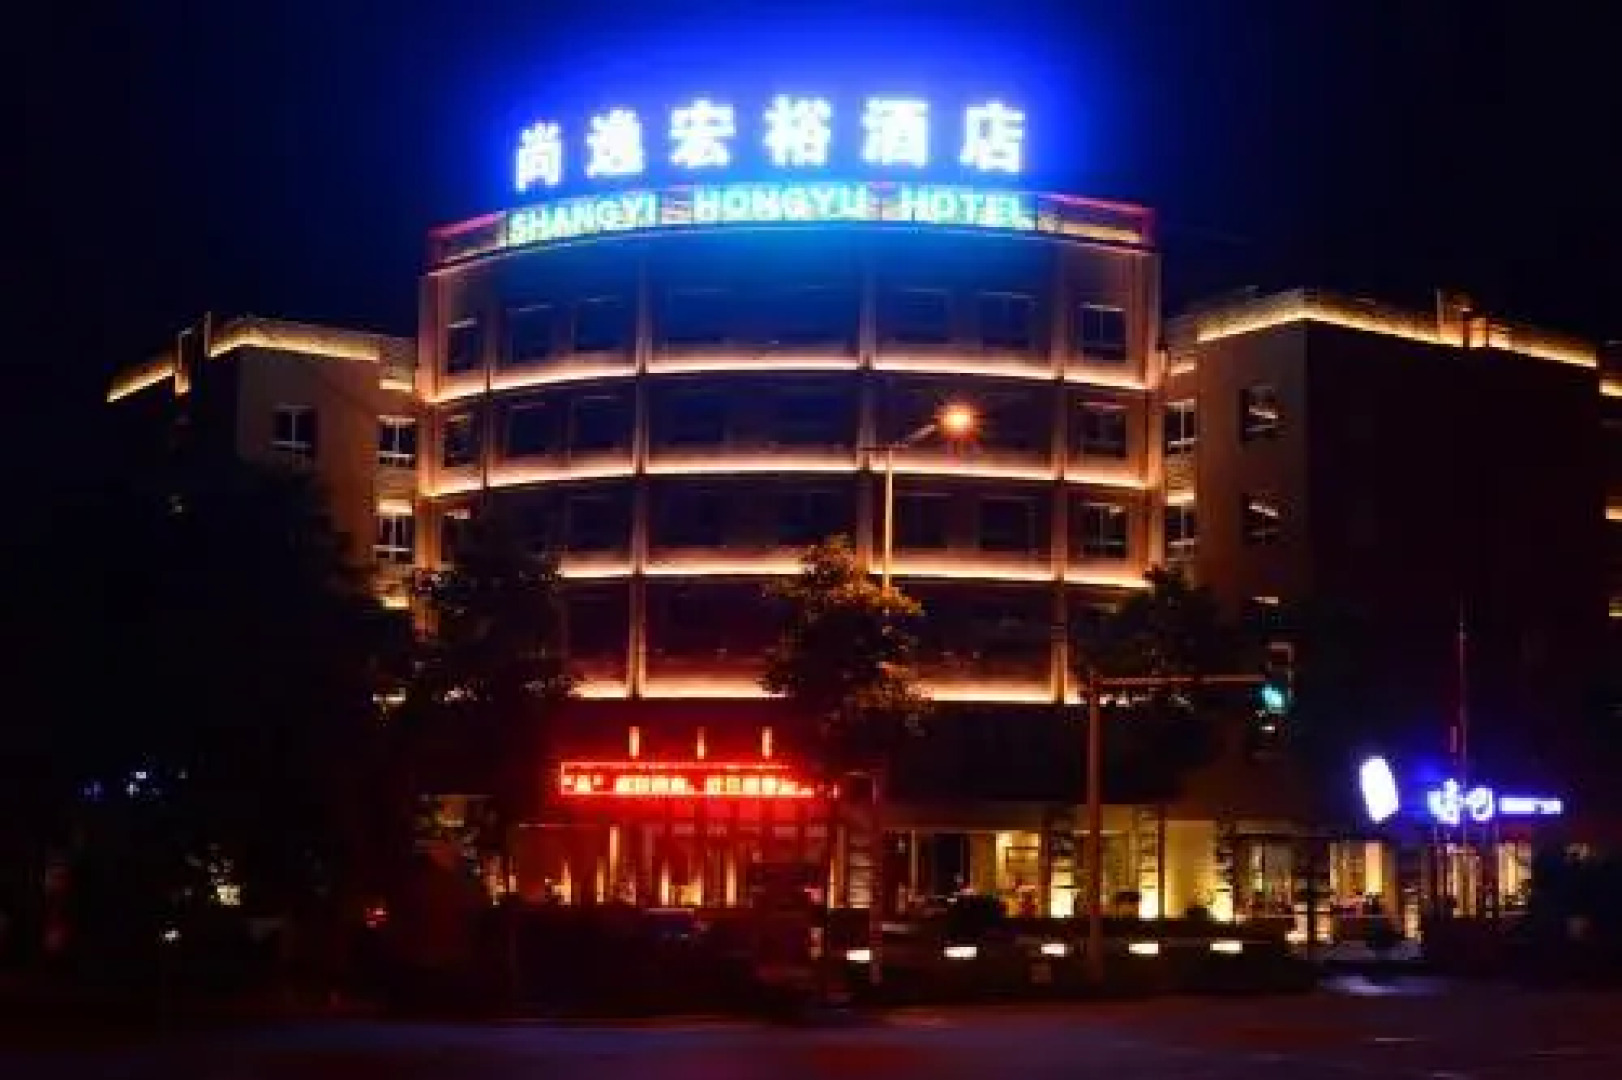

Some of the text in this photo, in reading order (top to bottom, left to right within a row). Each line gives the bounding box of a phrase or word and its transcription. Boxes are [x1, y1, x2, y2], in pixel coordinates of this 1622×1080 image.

[508, 184, 1036, 245] SHANGYI HONGYU HOTEL
